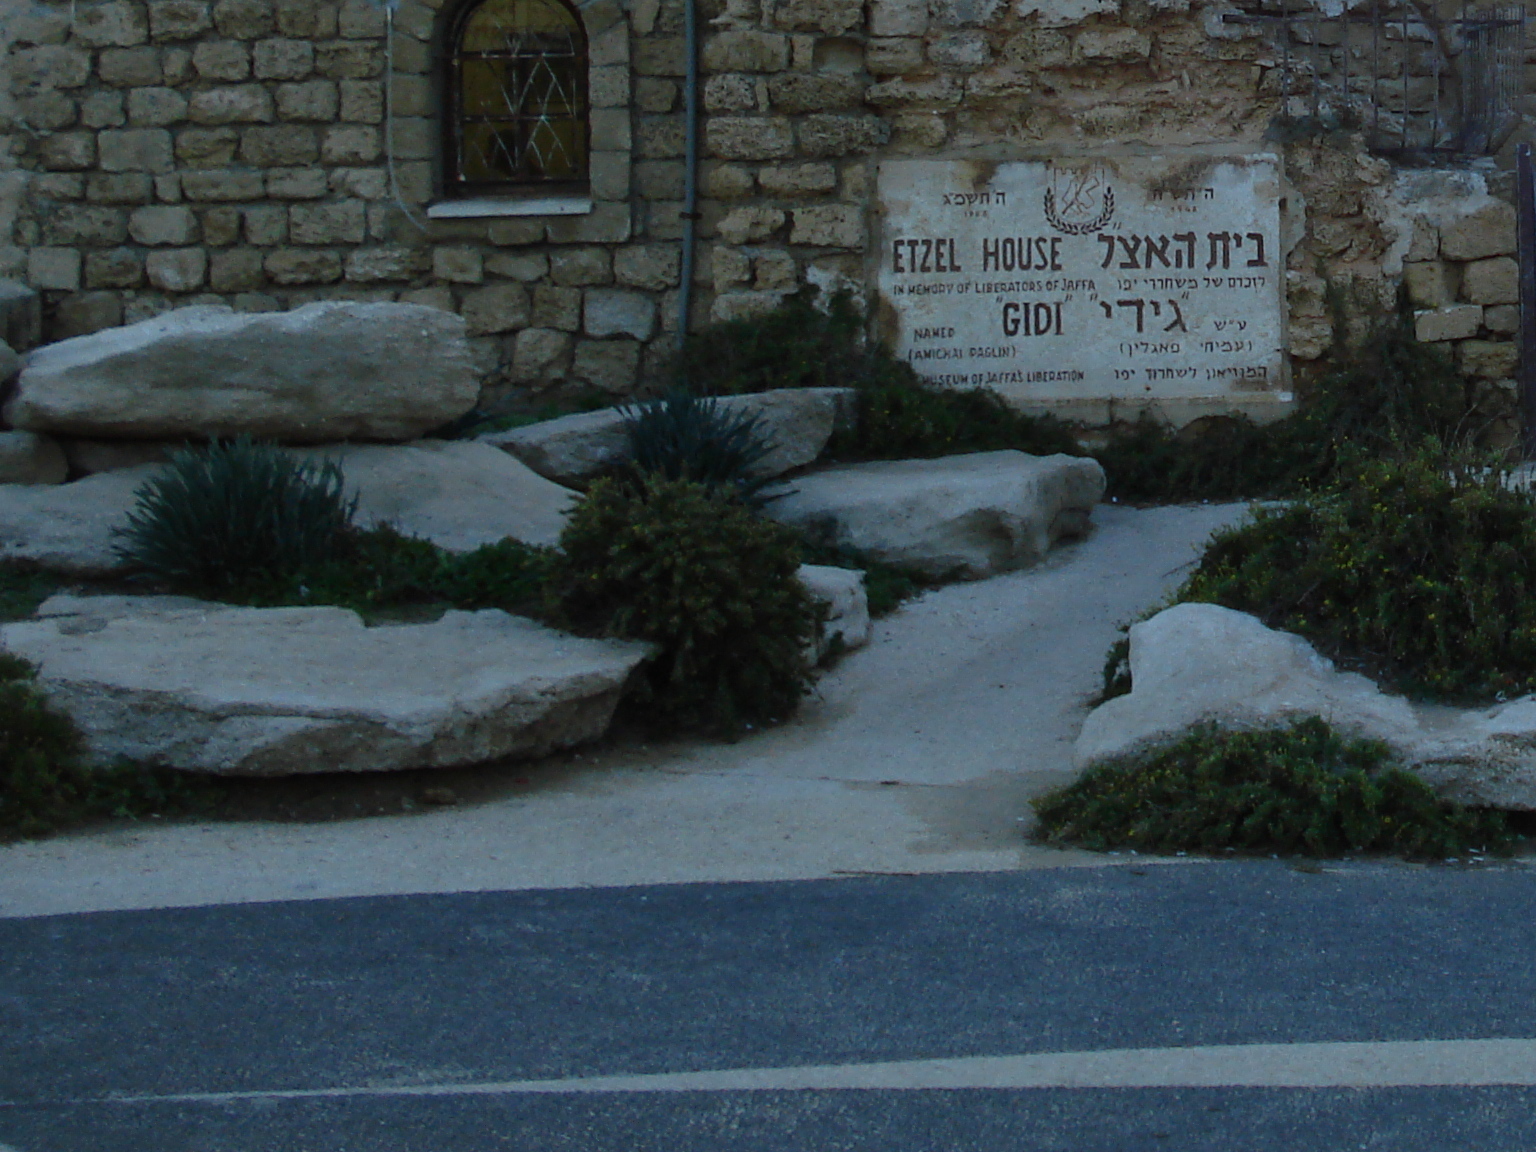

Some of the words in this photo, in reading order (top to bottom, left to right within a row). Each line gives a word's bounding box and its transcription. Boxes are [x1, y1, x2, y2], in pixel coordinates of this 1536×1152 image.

[893, 237, 962, 273] ETZEL
[982, 236, 1063, 271] HOUSE
[1206, 231, 1268, 270] בית
[893, 284, 904, 296] IN
[908, 283, 954, 296] MEMORY
[957, 281, 971, 294] OF
[975, 280, 1043, 294] LIBERATORS
[1046, 279, 1058, 292] OF
[1061, 278, 1096, 292] JAFFA
[1117, 278, 1137, 290] יפו
[1143, 277, 1199, 289] משחררי
[1203, 276, 1223, 288] של
[1228, 276, 1266, 289] לזכרם
[914, 327, 955, 342] NAMED
[908, 348, 963, 361] (AMICHAI
[969, 346, 1017, 359] PAGLIN)
[922, 373, 968, 386] MUSEUM
[971, 372, 983, 386] OF
[985, 370, 1024, 384] JAFFA'S
[1027, 370, 1085, 383] LIBERATION
[1114, 369, 1136, 380] יפו
